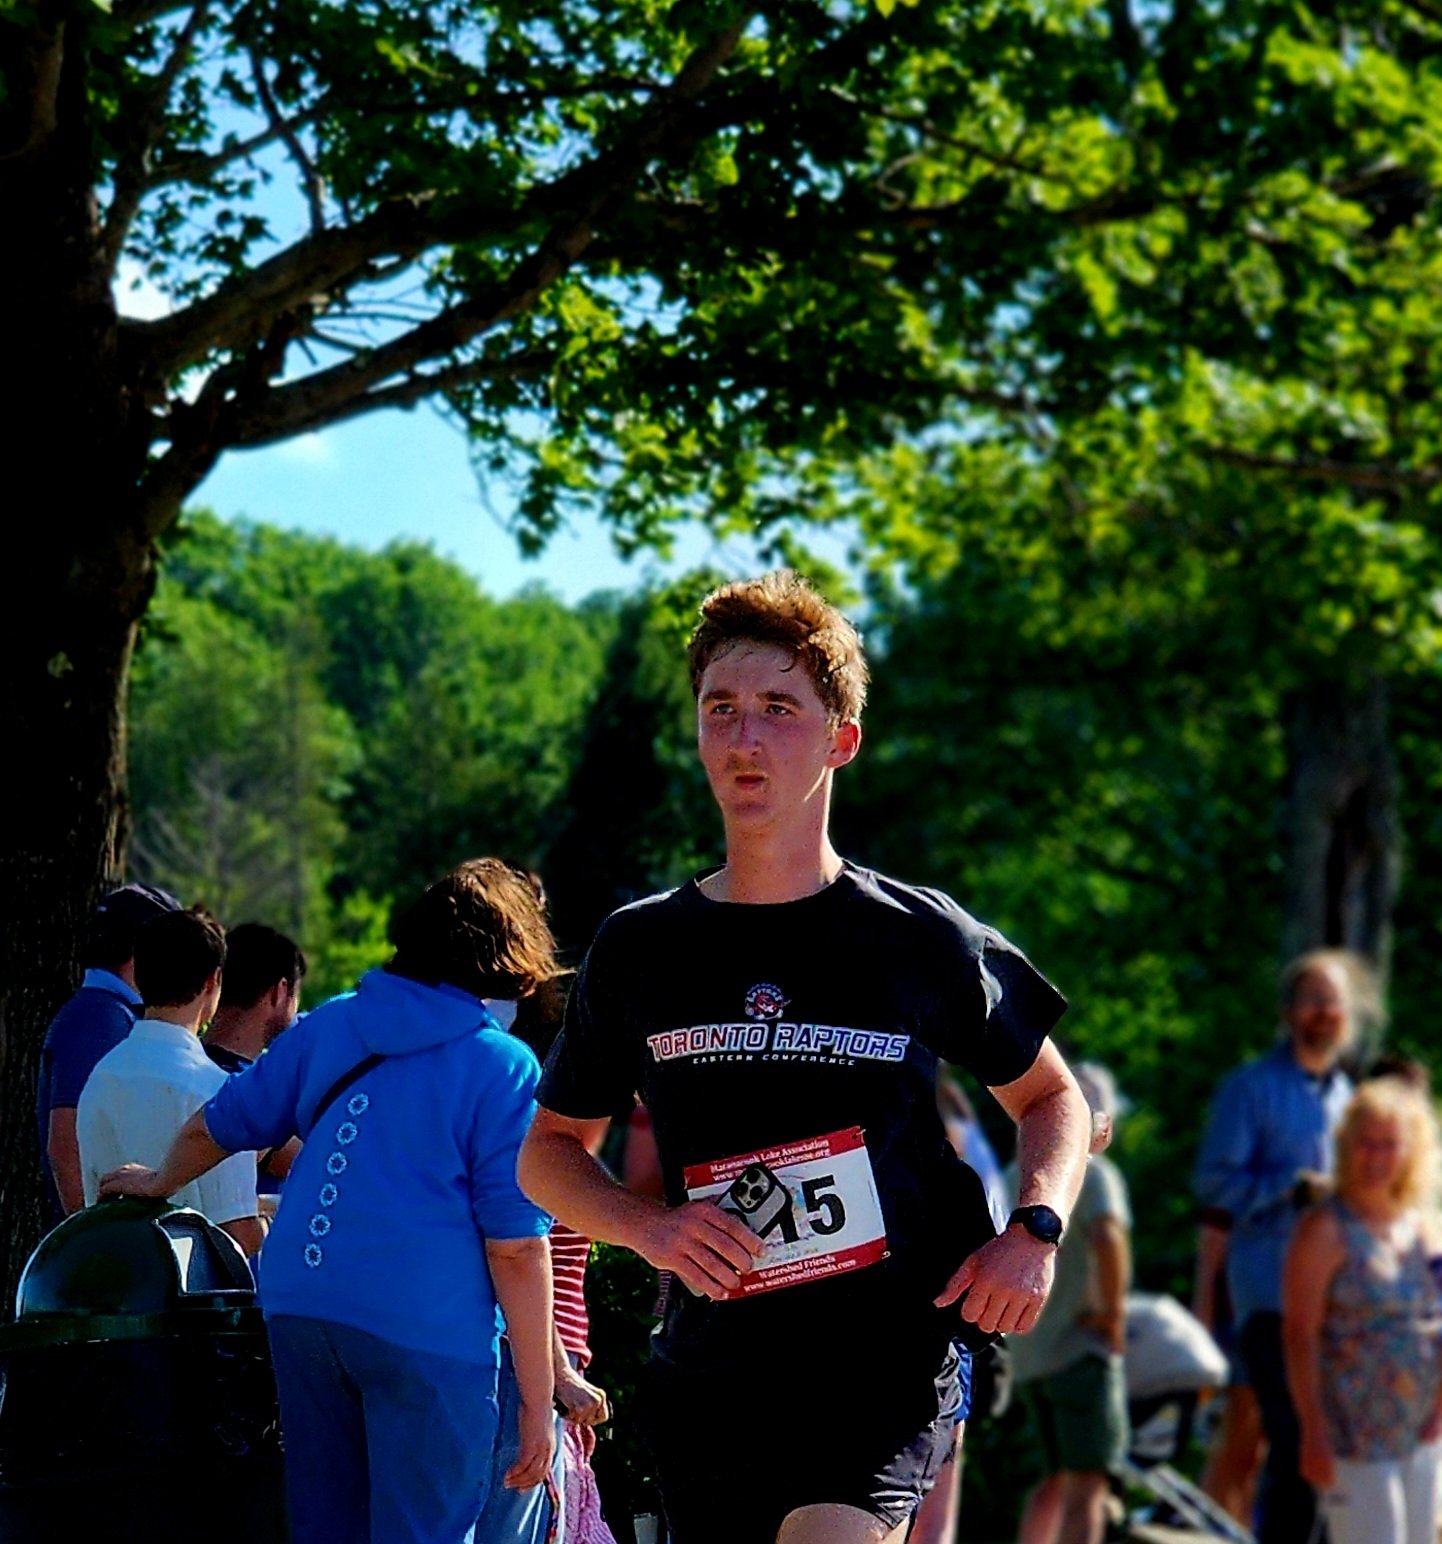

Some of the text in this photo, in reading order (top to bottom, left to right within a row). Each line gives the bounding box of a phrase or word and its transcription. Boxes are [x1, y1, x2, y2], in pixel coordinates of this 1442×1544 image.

[647, 1023, 910, 1063] TORONTO RAPTORS
[693, 1054, 855, 1066] EASTERN CONFERENCE
[760, 1149, 781, 1162] Lake
[781, 1139, 830, 1157] Association
[743, 1259, 857, 1292] www.watershedfriends.com
[759, 1261, 803, 1279] Watershed
[804, 1254, 836, 1270] Friends
